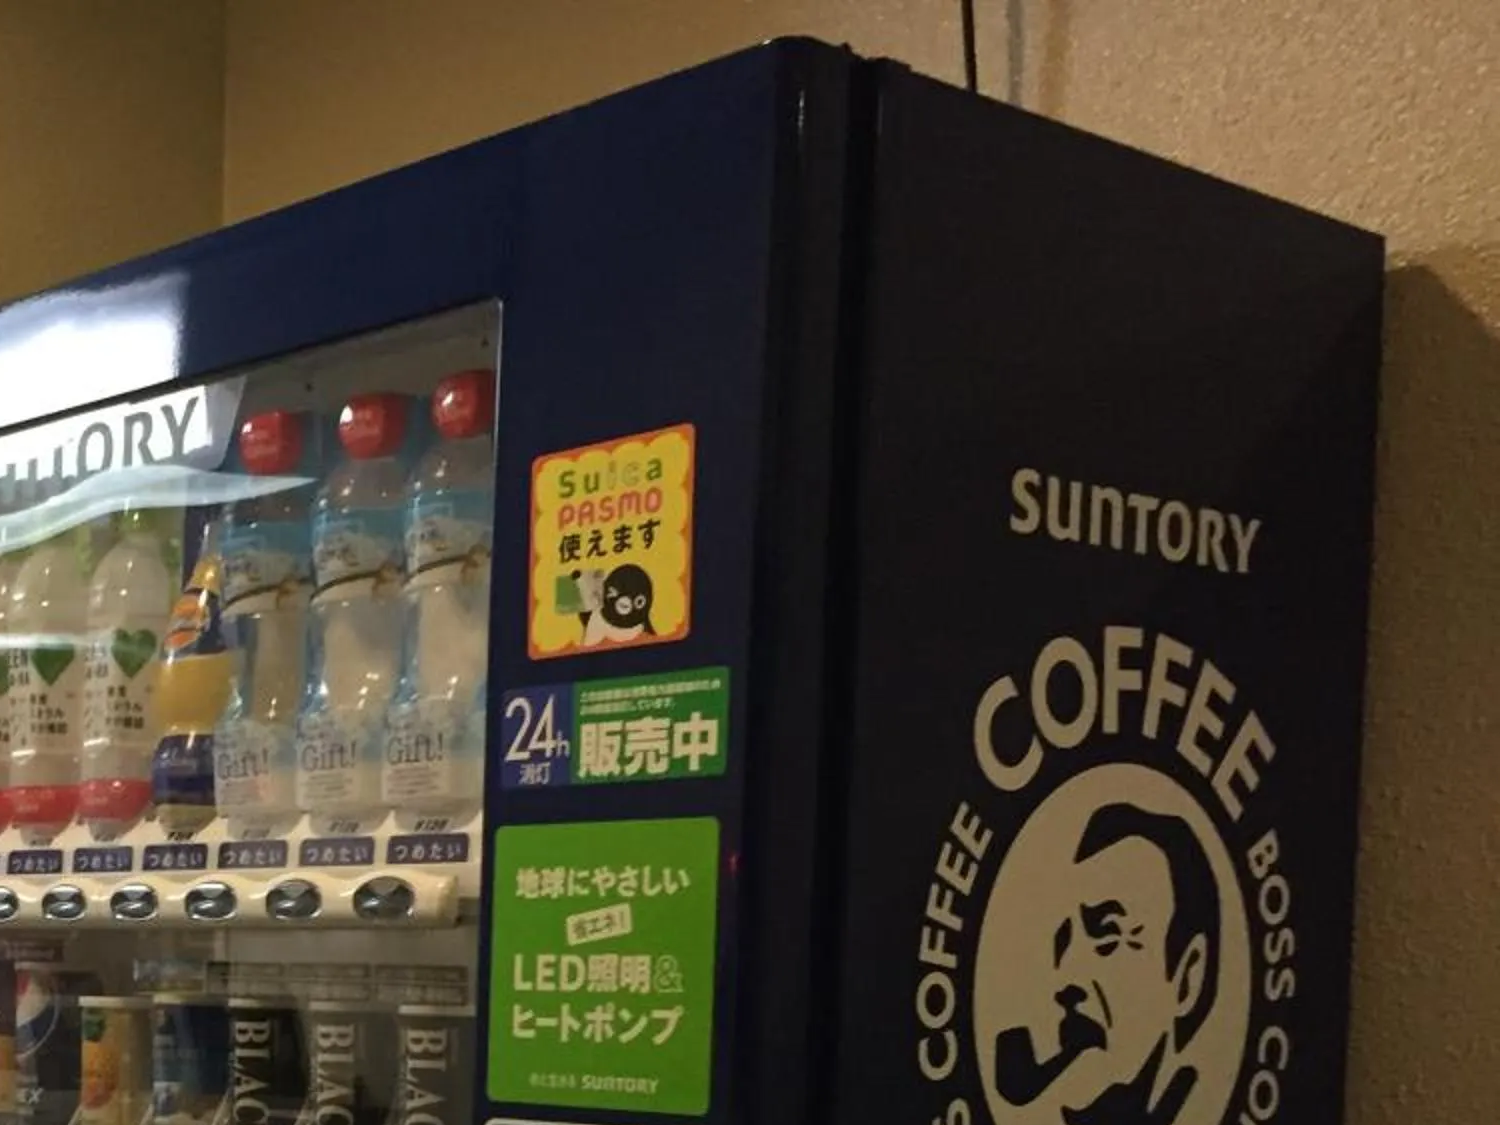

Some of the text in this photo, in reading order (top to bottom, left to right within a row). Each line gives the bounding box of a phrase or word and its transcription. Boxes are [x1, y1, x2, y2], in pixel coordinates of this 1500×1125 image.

[558, 457, 663, 499] Suica
[556, 486, 664, 531] PASMO
[558, 519, 661, 564] 使えます
[577, 711, 719, 779] 販売中
[973, 625, 1277, 823] COFFEE
[301, 740, 357, 772] Gift!
[386, 732, 445, 766] Gift!
[393, 841, 463, 861] つめたい
[515, 865, 691, 899] 地球にやさしい
[1246, 828, 1296, 1002] BOSS
[915, 800, 995, 1082] COFFEE
[512, 1001, 685, 1046] ヒートポンプ
